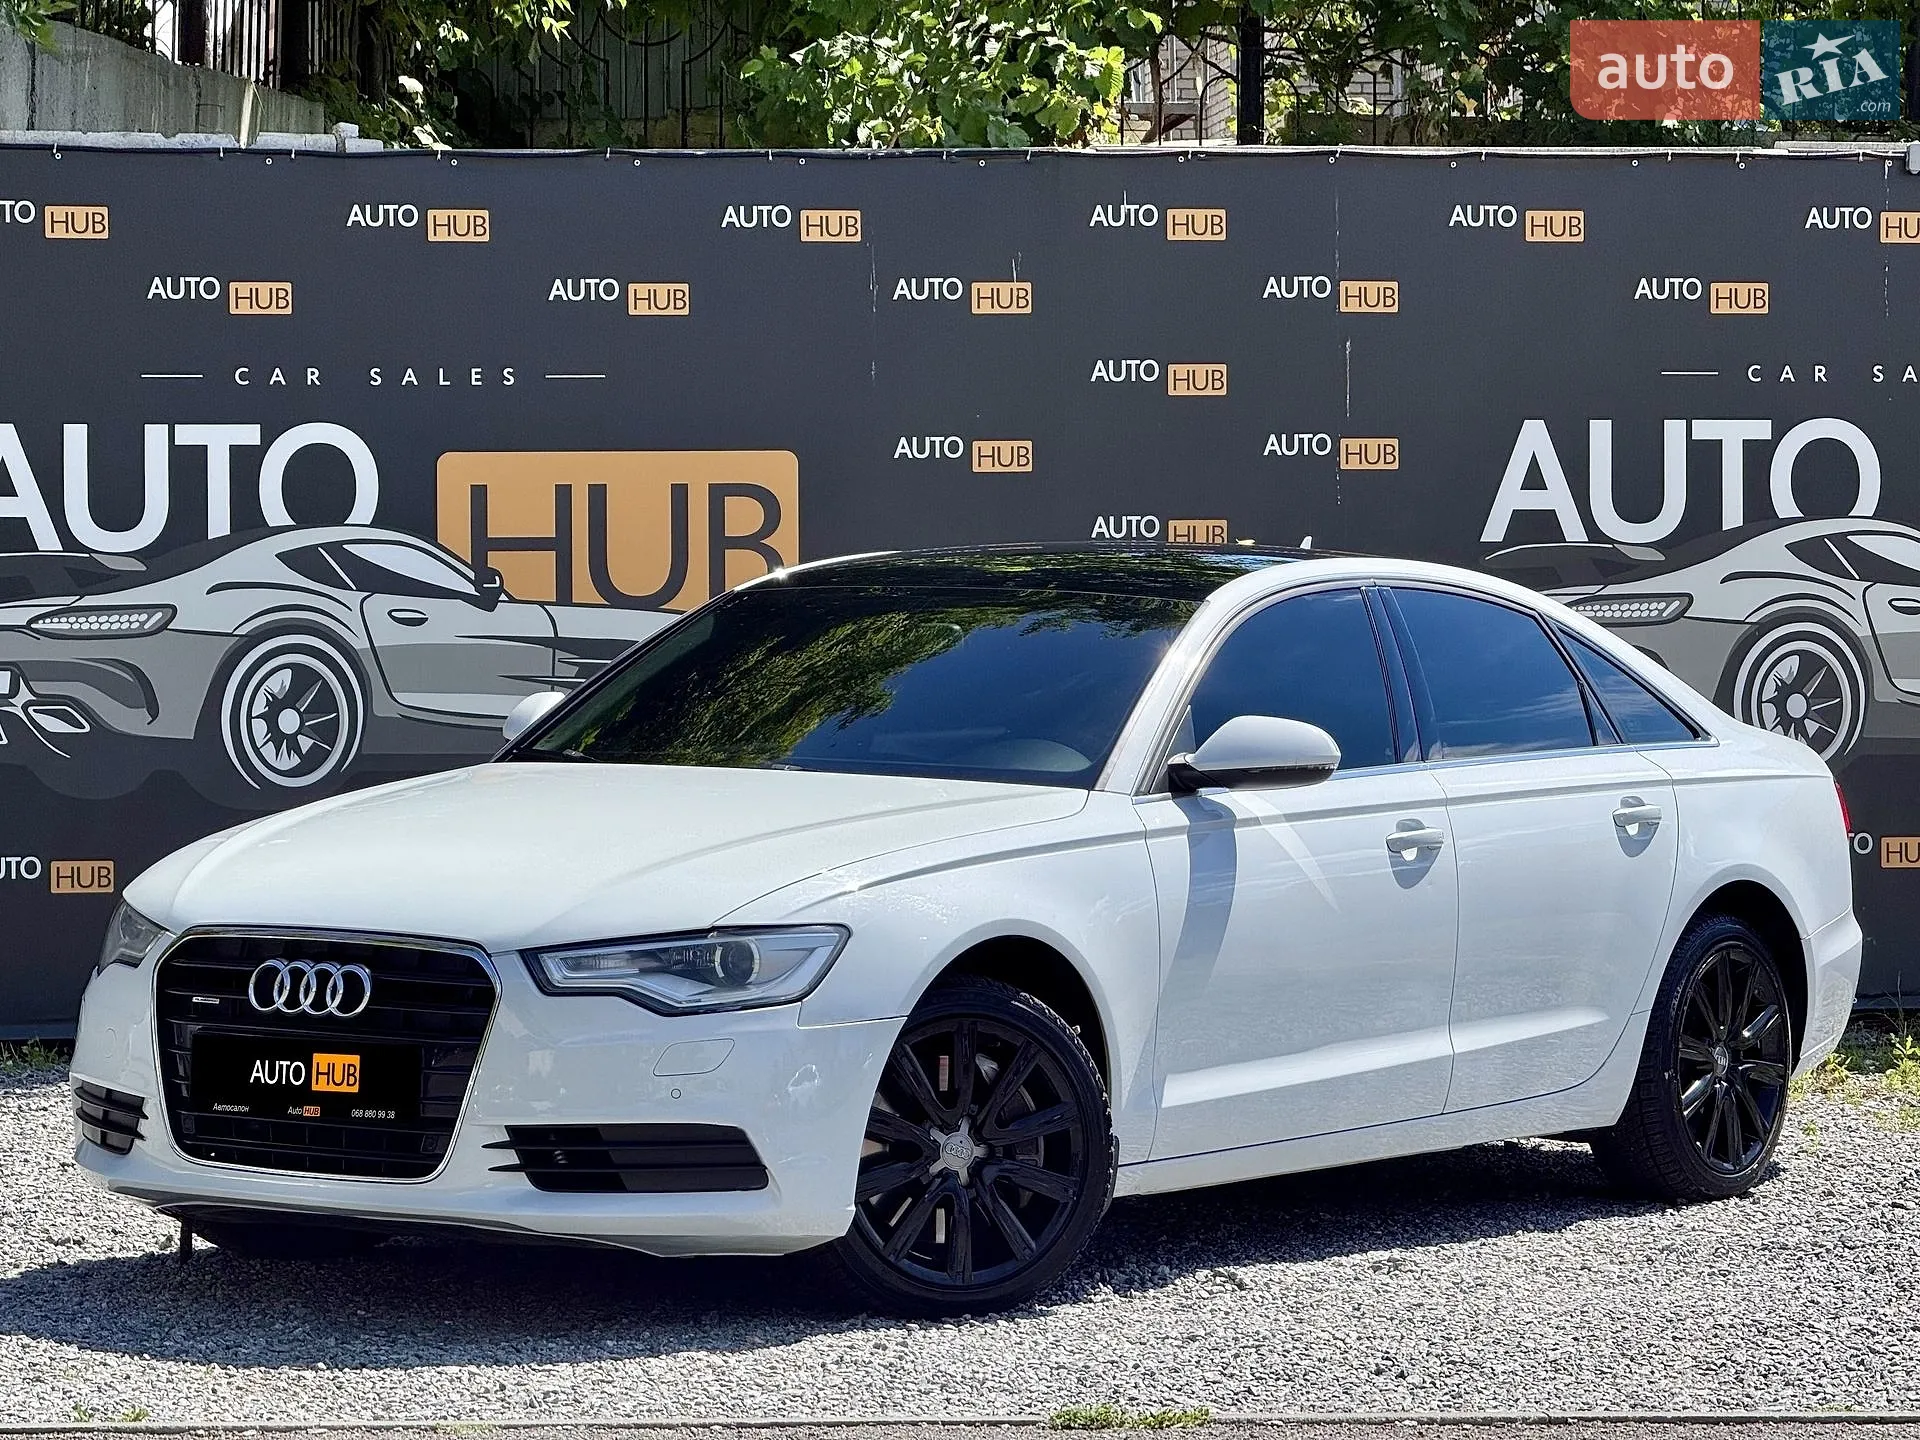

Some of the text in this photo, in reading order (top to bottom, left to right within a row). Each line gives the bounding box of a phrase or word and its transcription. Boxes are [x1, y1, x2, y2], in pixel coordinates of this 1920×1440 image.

[50, 211, 106, 234] HUB
[346, 204, 486, 237] AUTO HUB
[721, 205, 858, 237] AUTO HUB
[1089, 204, 1223, 236] AUTO HUB
[1449, 205, 1581, 237] AUTO HUB
[1804, 206, 1873, 230] AUTO
[146, 276, 289, 310] AUTO HUB
[547, 278, 686, 311] AUTO HUB
[892, 277, 1029, 310] AUTO HUB
[1262, 276, 1396, 308] AUTO HUB
[1633, 277, 1766, 310] AUTO HUB
[234, 367, 515, 386] CAR SALES
[1090, 359, 1224, 391] AUTO HUB
[1747, 364, 1828, 383] CAR
[893, 435, 1030, 468] AUTO HUB
[1262, 433, 1396, 465] AUTO HUB
[1479, 417, 1881, 543] AUTO
[470, 482, 784, 608] HUB
[1090, 515, 1225, 543] AUTO HUB
[56, 866, 111, 889] HUB
[250, 1059, 358, 1087] AUTO HUB
